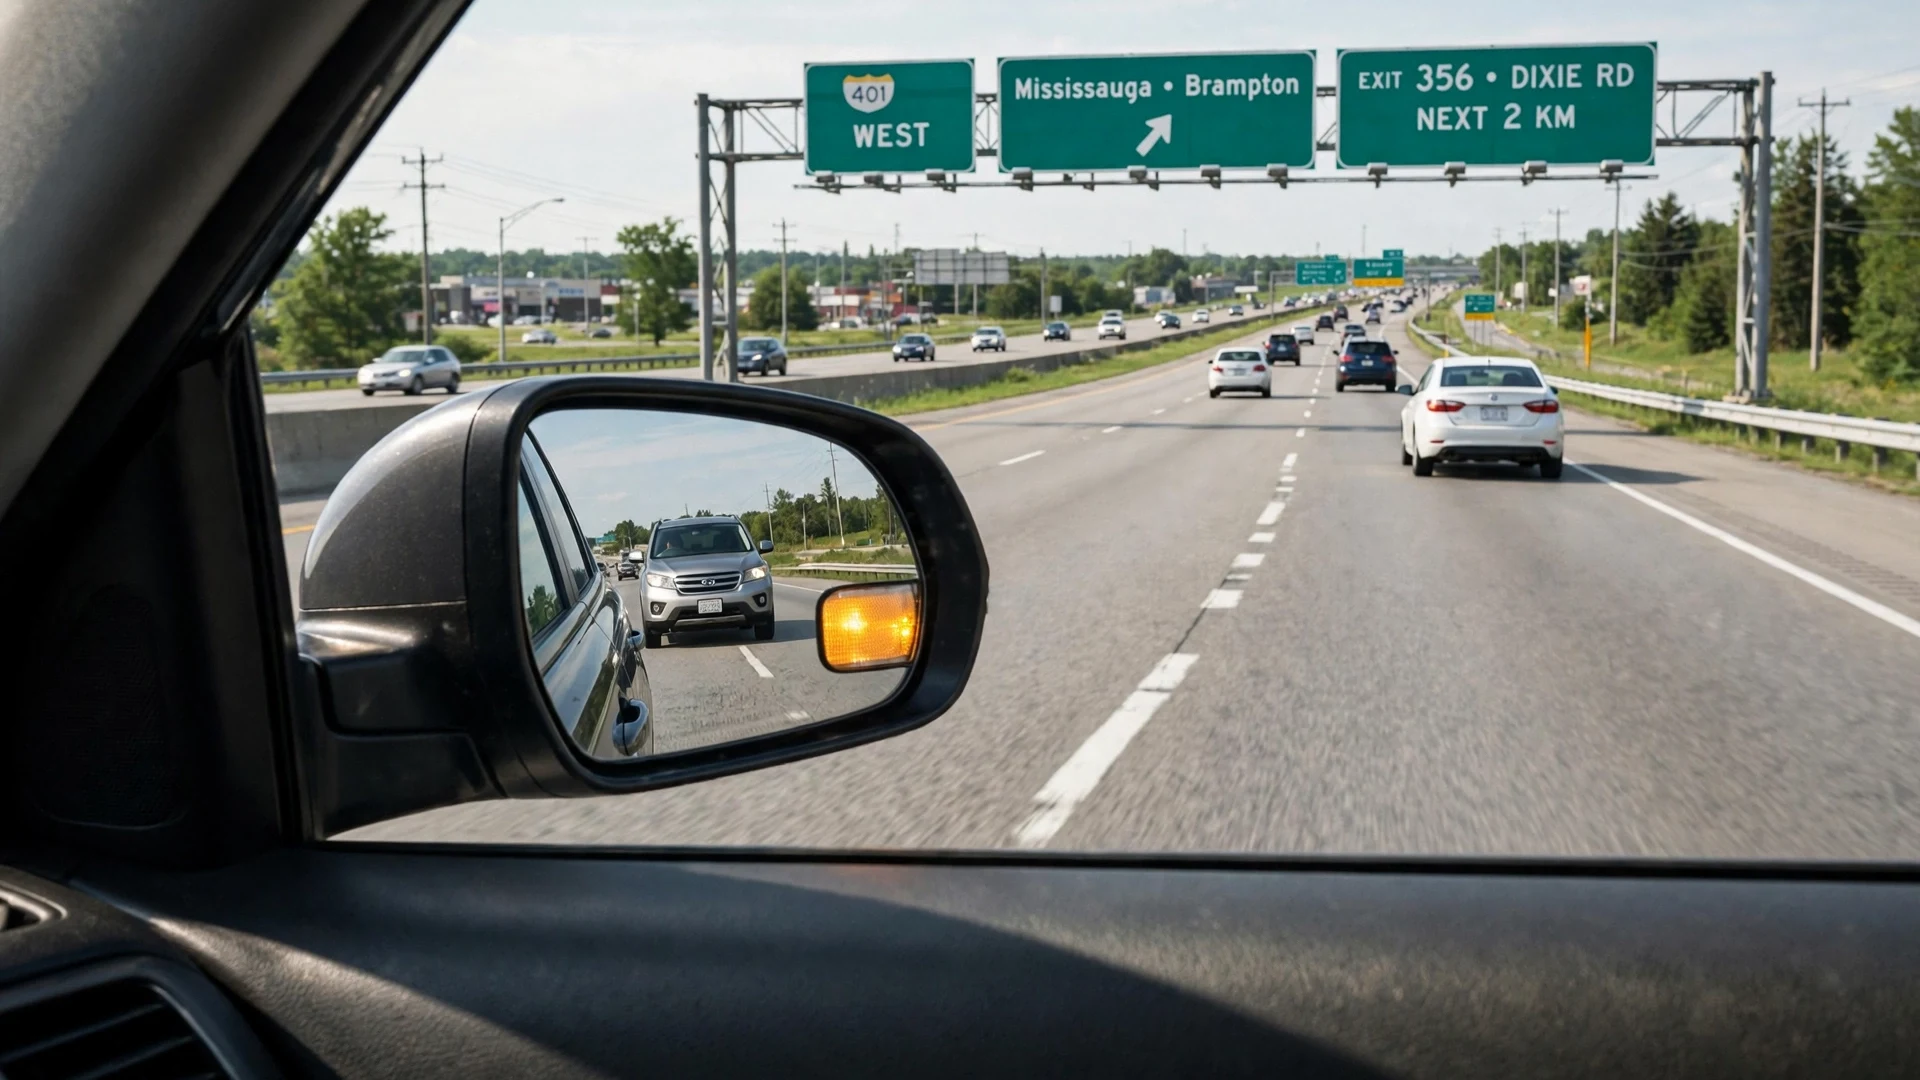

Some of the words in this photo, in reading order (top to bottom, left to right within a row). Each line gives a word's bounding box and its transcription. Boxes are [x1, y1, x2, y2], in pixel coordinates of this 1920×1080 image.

[1015, 77, 1152, 104] Mississauga
[1185, 73, 1300, 101] Brampton
[1358, 71, 1402, 90] EXIT
[1416, 63, 1474, 92] 356
[1511, 64, 1582, 89] DIXIE
[1596, 63, 1635, 88] RD
[852, 85, 886, 103] 401
[1417, 106, 1488, 131] NEXT
[1503, 103, 1522, 130] 2
[1535, 104, 1576, 129] KM
[853, 122, 930, 148] WEST
